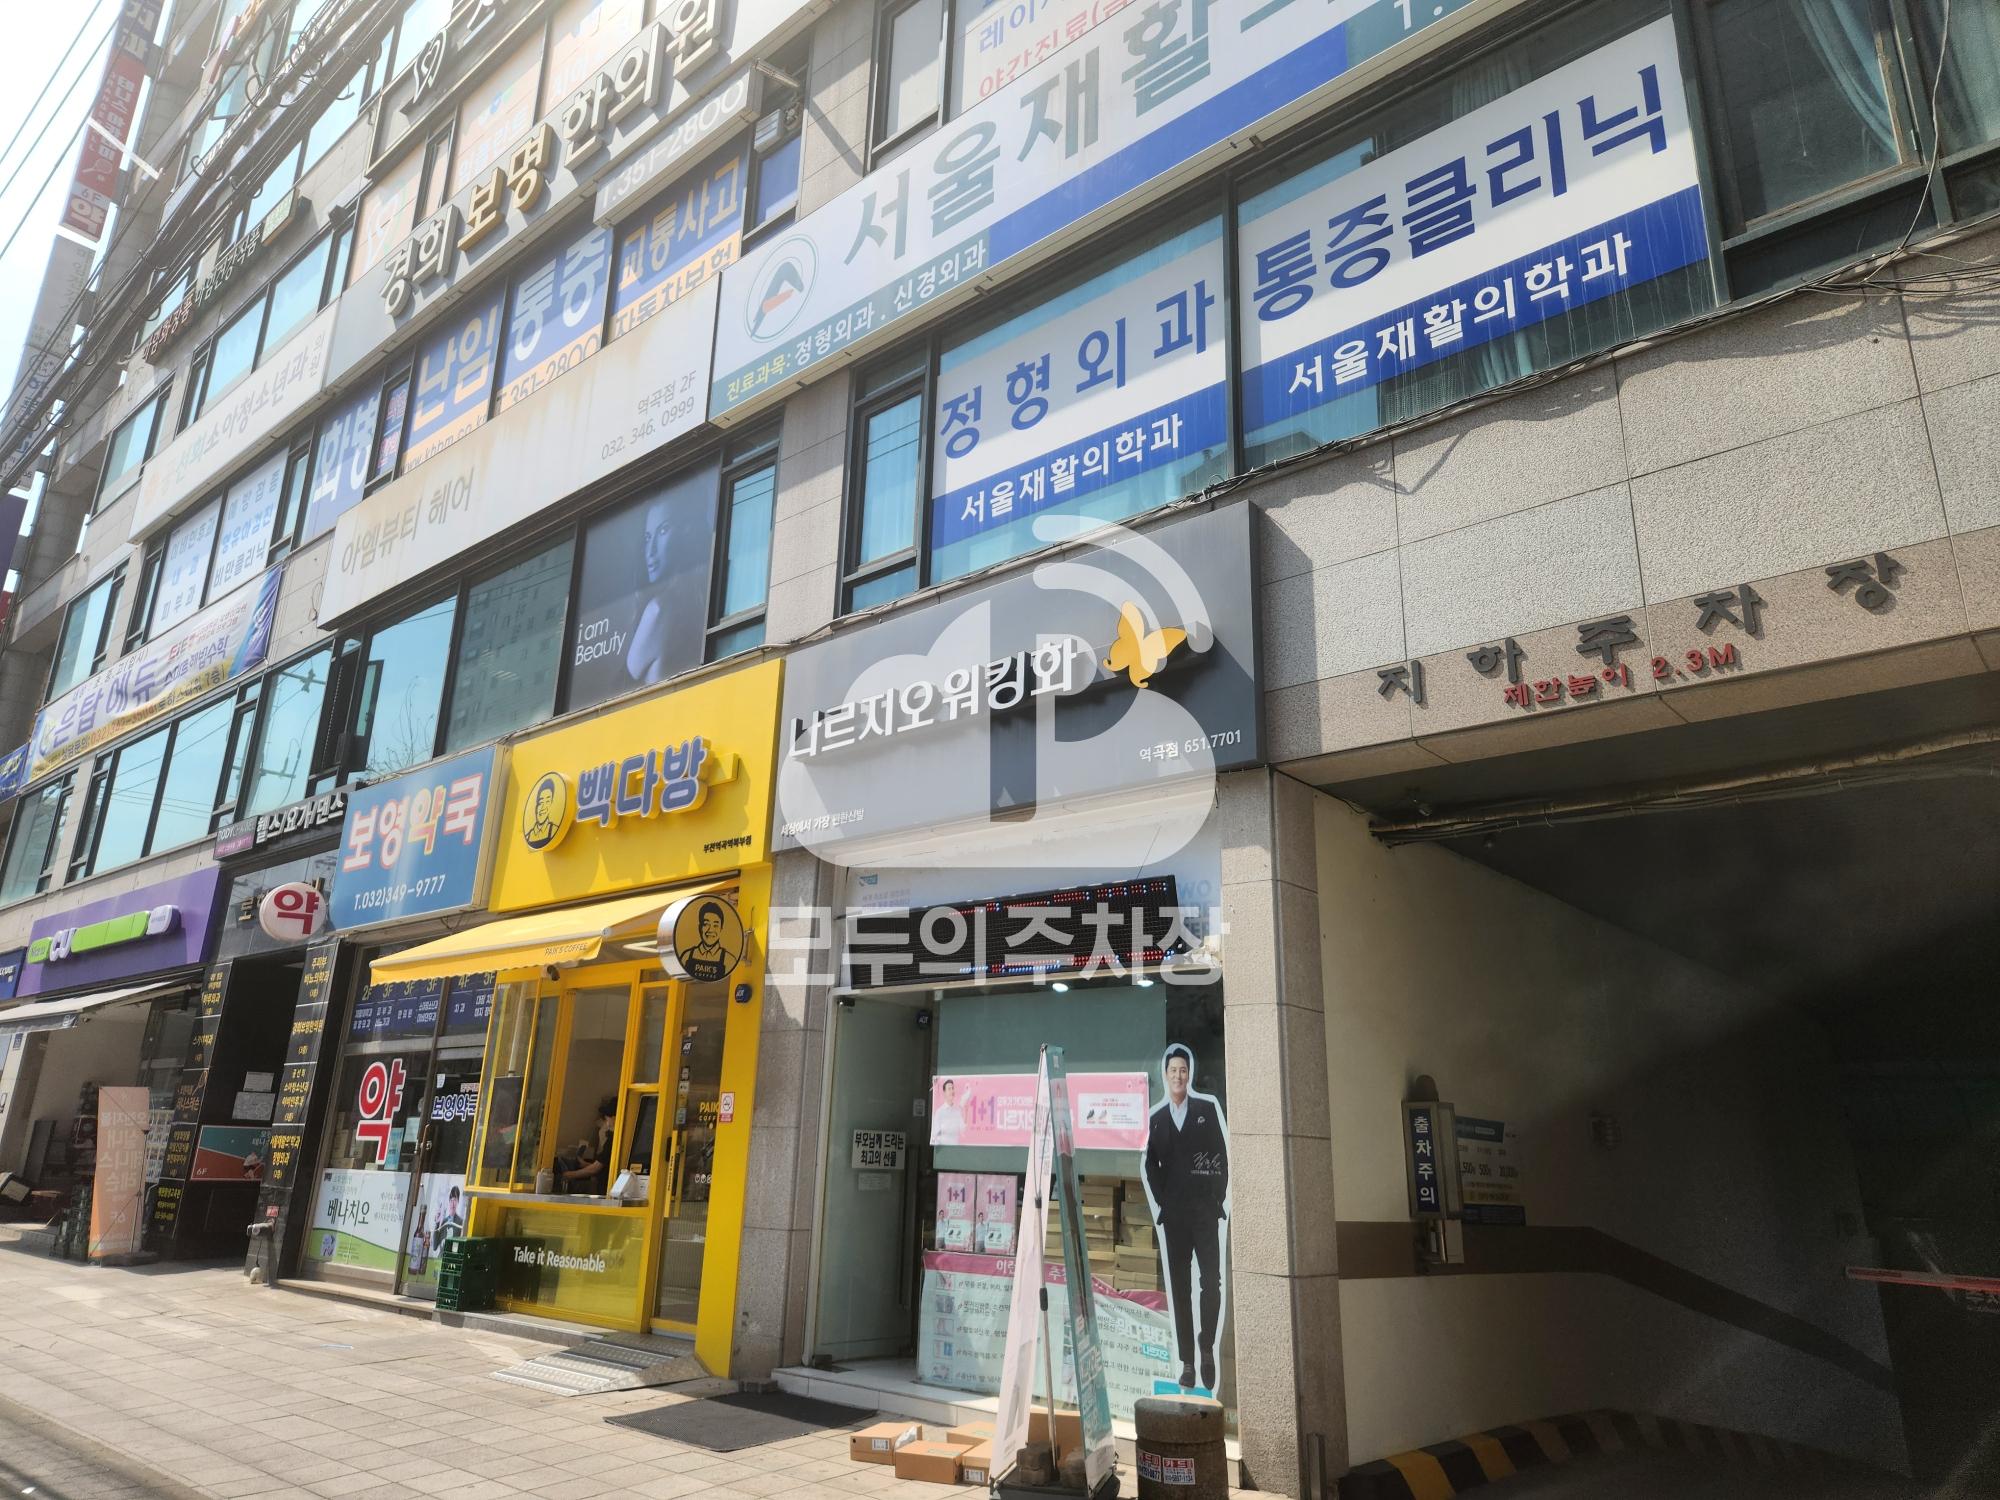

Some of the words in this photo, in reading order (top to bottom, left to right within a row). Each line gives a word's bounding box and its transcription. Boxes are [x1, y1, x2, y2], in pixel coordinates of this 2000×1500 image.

[843, 0, 1292, 266] 서울재활
[618, 160, 742, 292] 교통사고
[1254, 64, 1667, 321] 통증클리닉
[512, 225, 608, 362] 통증
[795, 307, 875, 366] 정형외과
[893, 240, 987, 314] 신경외과
[1288, 232, 1631, 395] 서울재활의학과
[413, 304, 498, 433] 난임
[637, 380, 677, 417] 역곡점
[681, 370, 698, 394] 2F
[941, 279, 1215, 460] 정형외과
[661, 398, 696, 430] 0999
[427, 466, 475, 526] 헤어
[960, 413, 1184, 522] 서울재활의학과
[575, 631, 627, 667] Beauty
[1376, 551, 1902, 704] 지하주차장
[789, 637, 1078, 760] 나르지오워킹화
[1504, 662, 1628, 708] 제한높이
[1652, 642, 1736, 680] 2.3M
[577, 736, 709, 827] 빽다방
[1139, 741, 1180, 764] 역곡점
[1184, 729, 1243, 754] 651.7701
[343, 772, 485, 873] 보영약국
[272, 889, 320, 936] 약
[353, 873, 446, 912] T.032)349-9777
[356, 1058, 408, 1165] 약
[855, 1131, 882, 1149] 부모님께
[884, 1133, 904, 1151] 드리는
[969, 1095, 995, 1125] 1+1
[860, 1150, 882, 1167] 최고의
[947, 1186, 966, 1204] 1+1
[986, 1188, 1006, 1206] 1+1
[1412, 1115, 1437, 1206] 출차주의
[327, 1198, 371, 1228] 베나치오
[513, 1246, 535, 1265] Take
[546, 1249, 606, 1274] Reasonable
